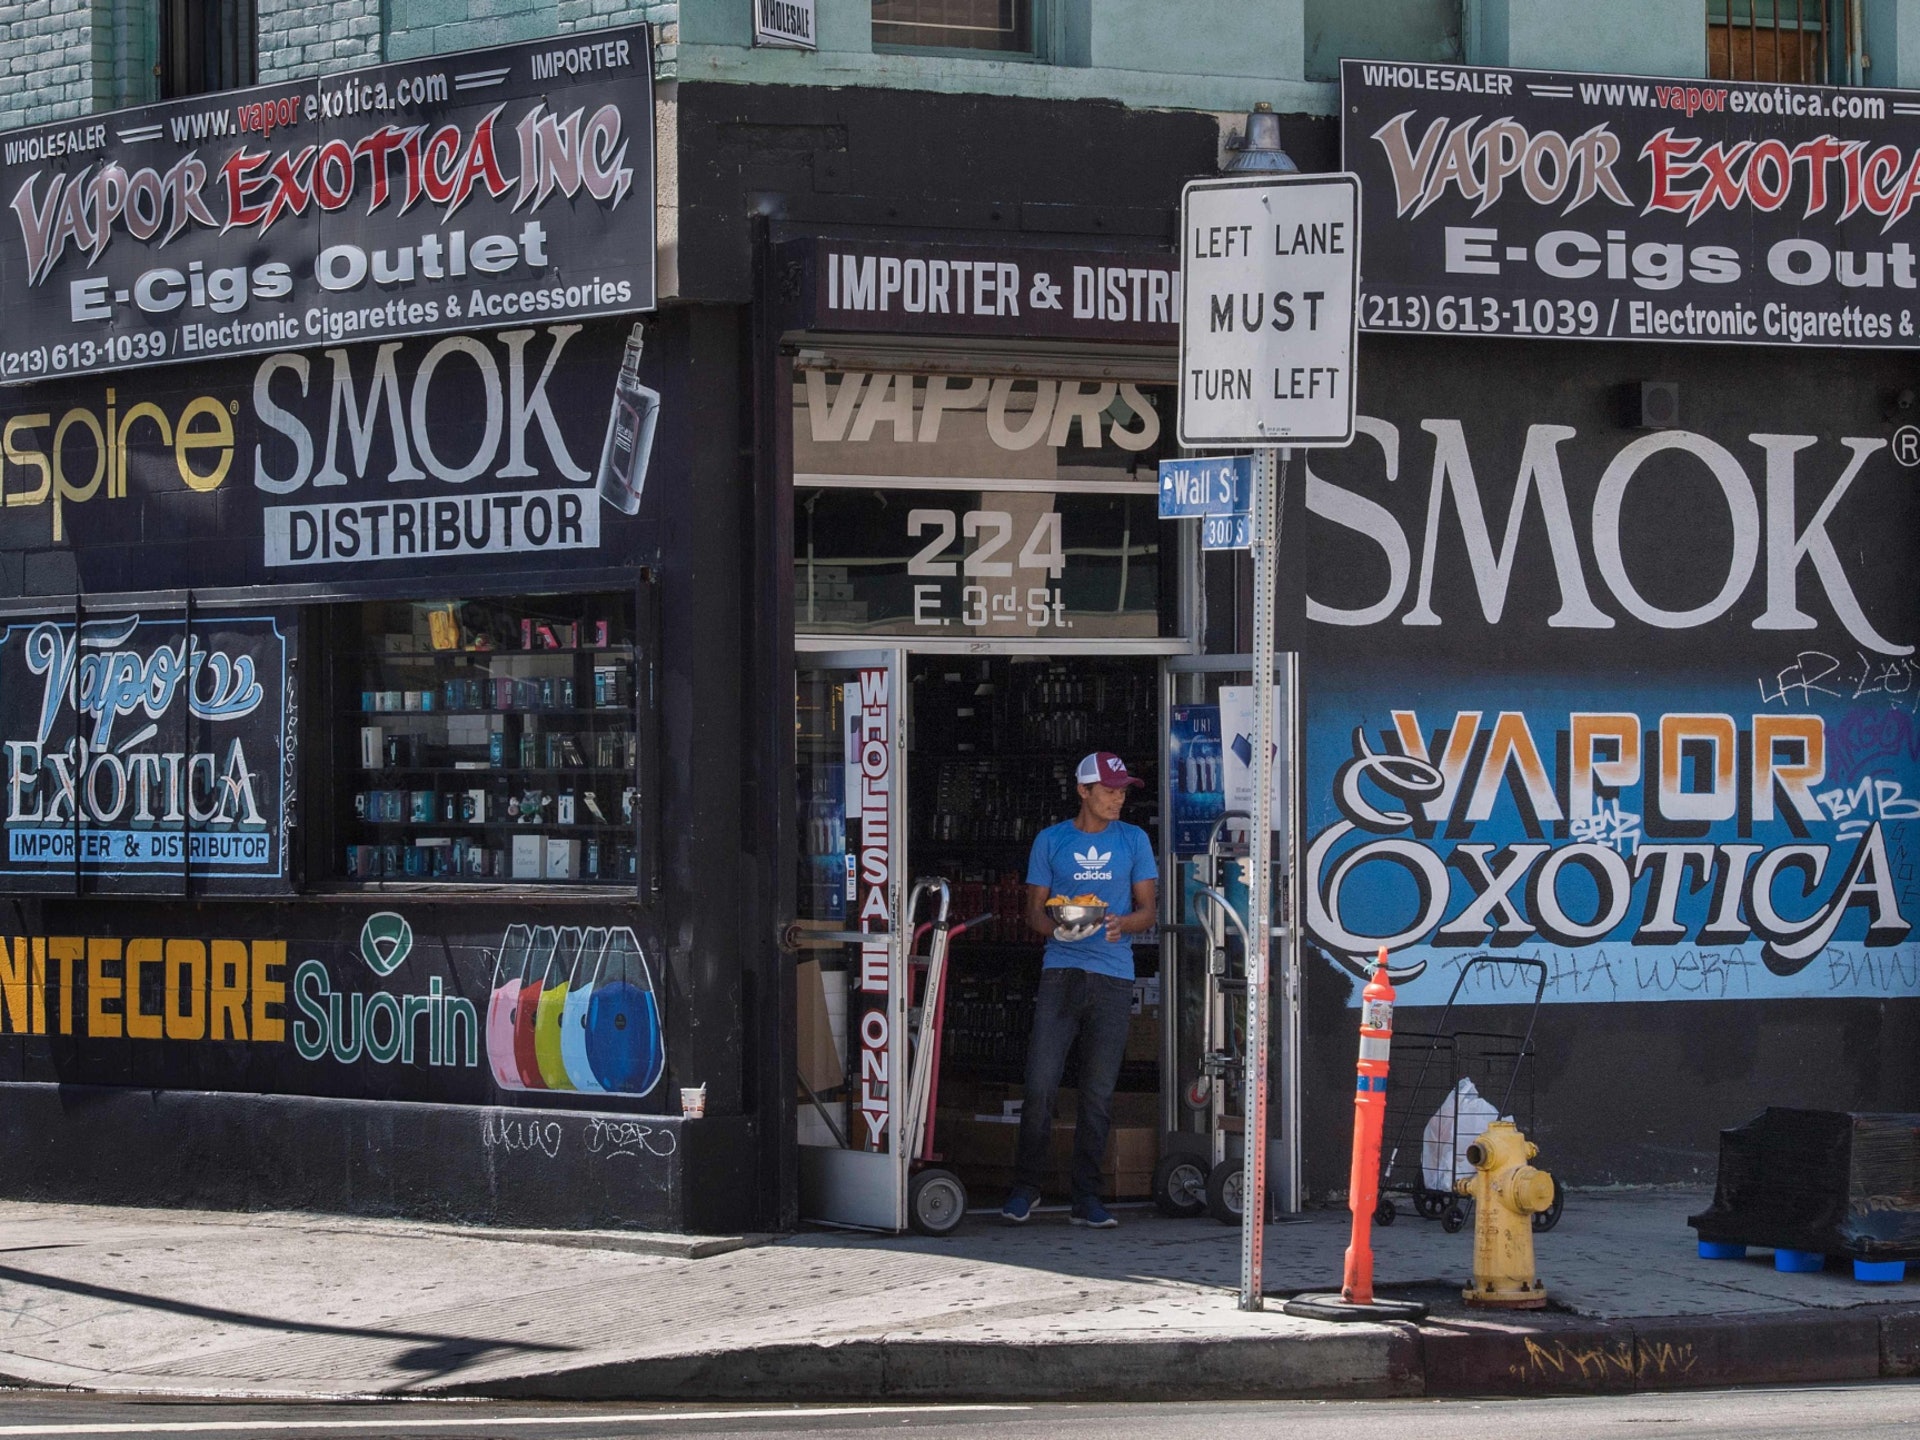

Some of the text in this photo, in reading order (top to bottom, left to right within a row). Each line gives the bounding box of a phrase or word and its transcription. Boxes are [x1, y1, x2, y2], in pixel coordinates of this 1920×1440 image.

[760, 0, 810, 39] WHOLESALE
[5, 124, 107, 166] WHOLESALER
[531, 38, 630, 80] IMPORTER
[1362, 65, 1513, 96] WHOLESALER
[9, 149, 221, 287] VAPOR
[215, 101, 520, 240] EXOTICA
[1370, 109, 1636, 221] VAPOR
[70, 220, 548, 323] E-Cigs Outlet
[1195, 222, 1344, 258] LEFT LANE
[1444, 226, 1742, 291] E-Cigs
[828, 253, 1179, 324] IMPORTER & DISTRI
[1210, 291, 1324, 333] MUST
[1359, 294, 1431, 331] (213)
[1435, 295, 1599, 334] 613-1039
[1629, 301, 1757, 335] Electronic
[1763, 302, 1892, 343] Cigarettes
[1899, 309, 1914, 337] &
[0, 346, 48, 376] (213)
[182, 318, 299, 352] Electronic
[304, 299, 439, 341] Cigarettes
[446, 294, 462, 317] &
[467, 277, 632, 318] Accessories
[253, 325, 592, 494] SMOK
[805, 370, 1160, 451] VAPORS
[1192, 367, 1339, 400] TURN LEFT
[0, 387, 234, 541] spire
[1174, 467, 1239, 505] Wall St
[289, 494, 583, 561] DISTRIBUTOR
[907, 509, 1065, 579] 224
[1208, 519, 1244, 544] 300 S
[1305, 415, 1915, 655] SMOK
[914, 584, 950, 626] E.
[1391, 709, 1826, 822] VAPOR
[15, 834, 267, 858] IMPORTER & DISTRIBUTOR
[1073, 870, 1112, 880] adidas
[1305, 726, 1912, 982] EXOTICA
[860, 669, 890, 1146] WHOLESALE ONLY
[0, 936, 287, 1042] NITECORE
[294, 960, 478, 1067] Suorin
